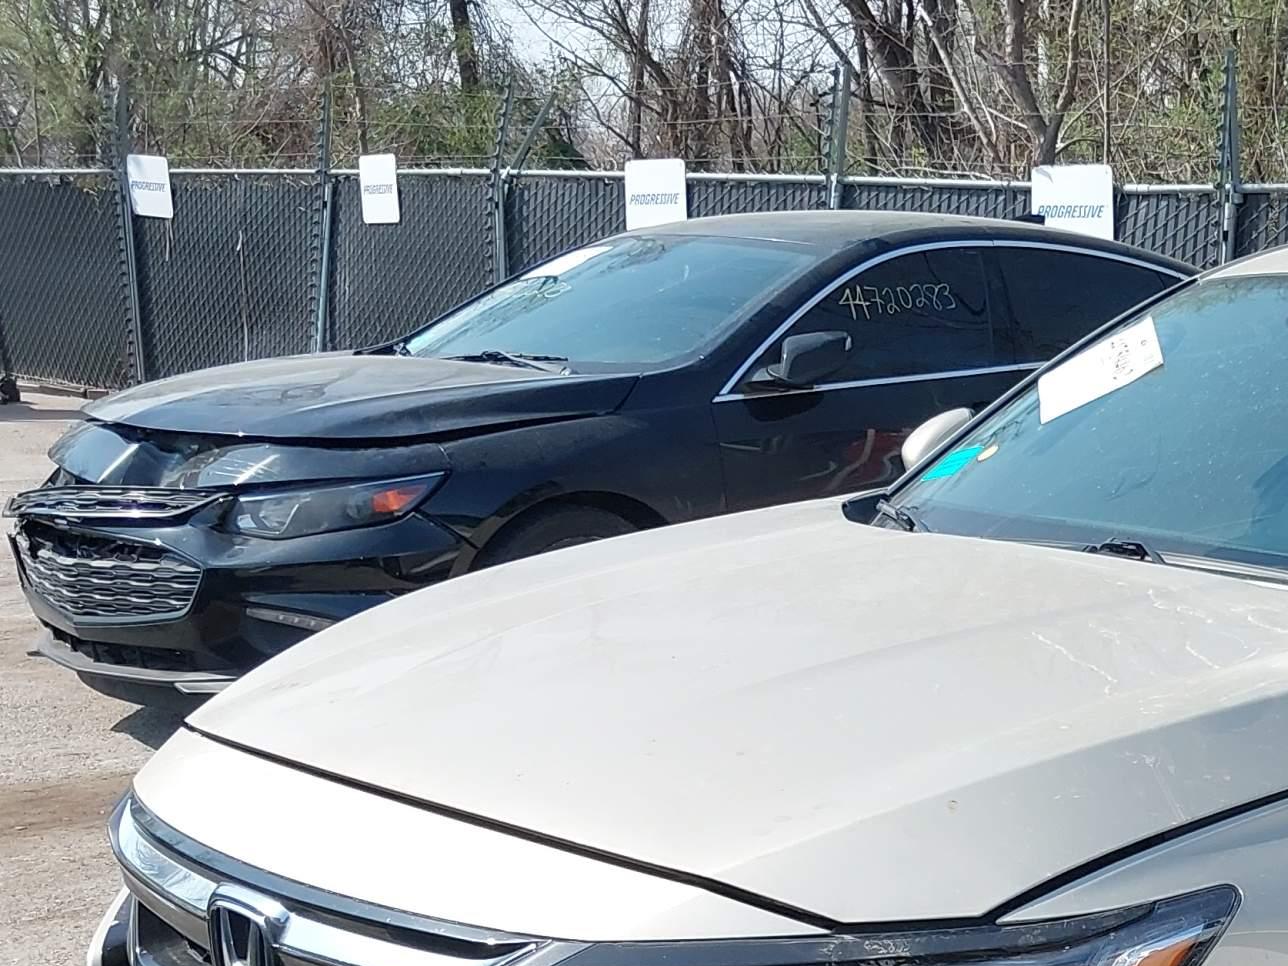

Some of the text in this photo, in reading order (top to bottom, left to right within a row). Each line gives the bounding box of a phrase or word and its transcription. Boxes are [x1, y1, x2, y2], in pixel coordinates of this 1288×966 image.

[629, 193, 680, 205] PROGRESSIVE
[1038, 205, 1104, 218] PROGRESSIVE
[838, 283, 957, 321] 44720283
